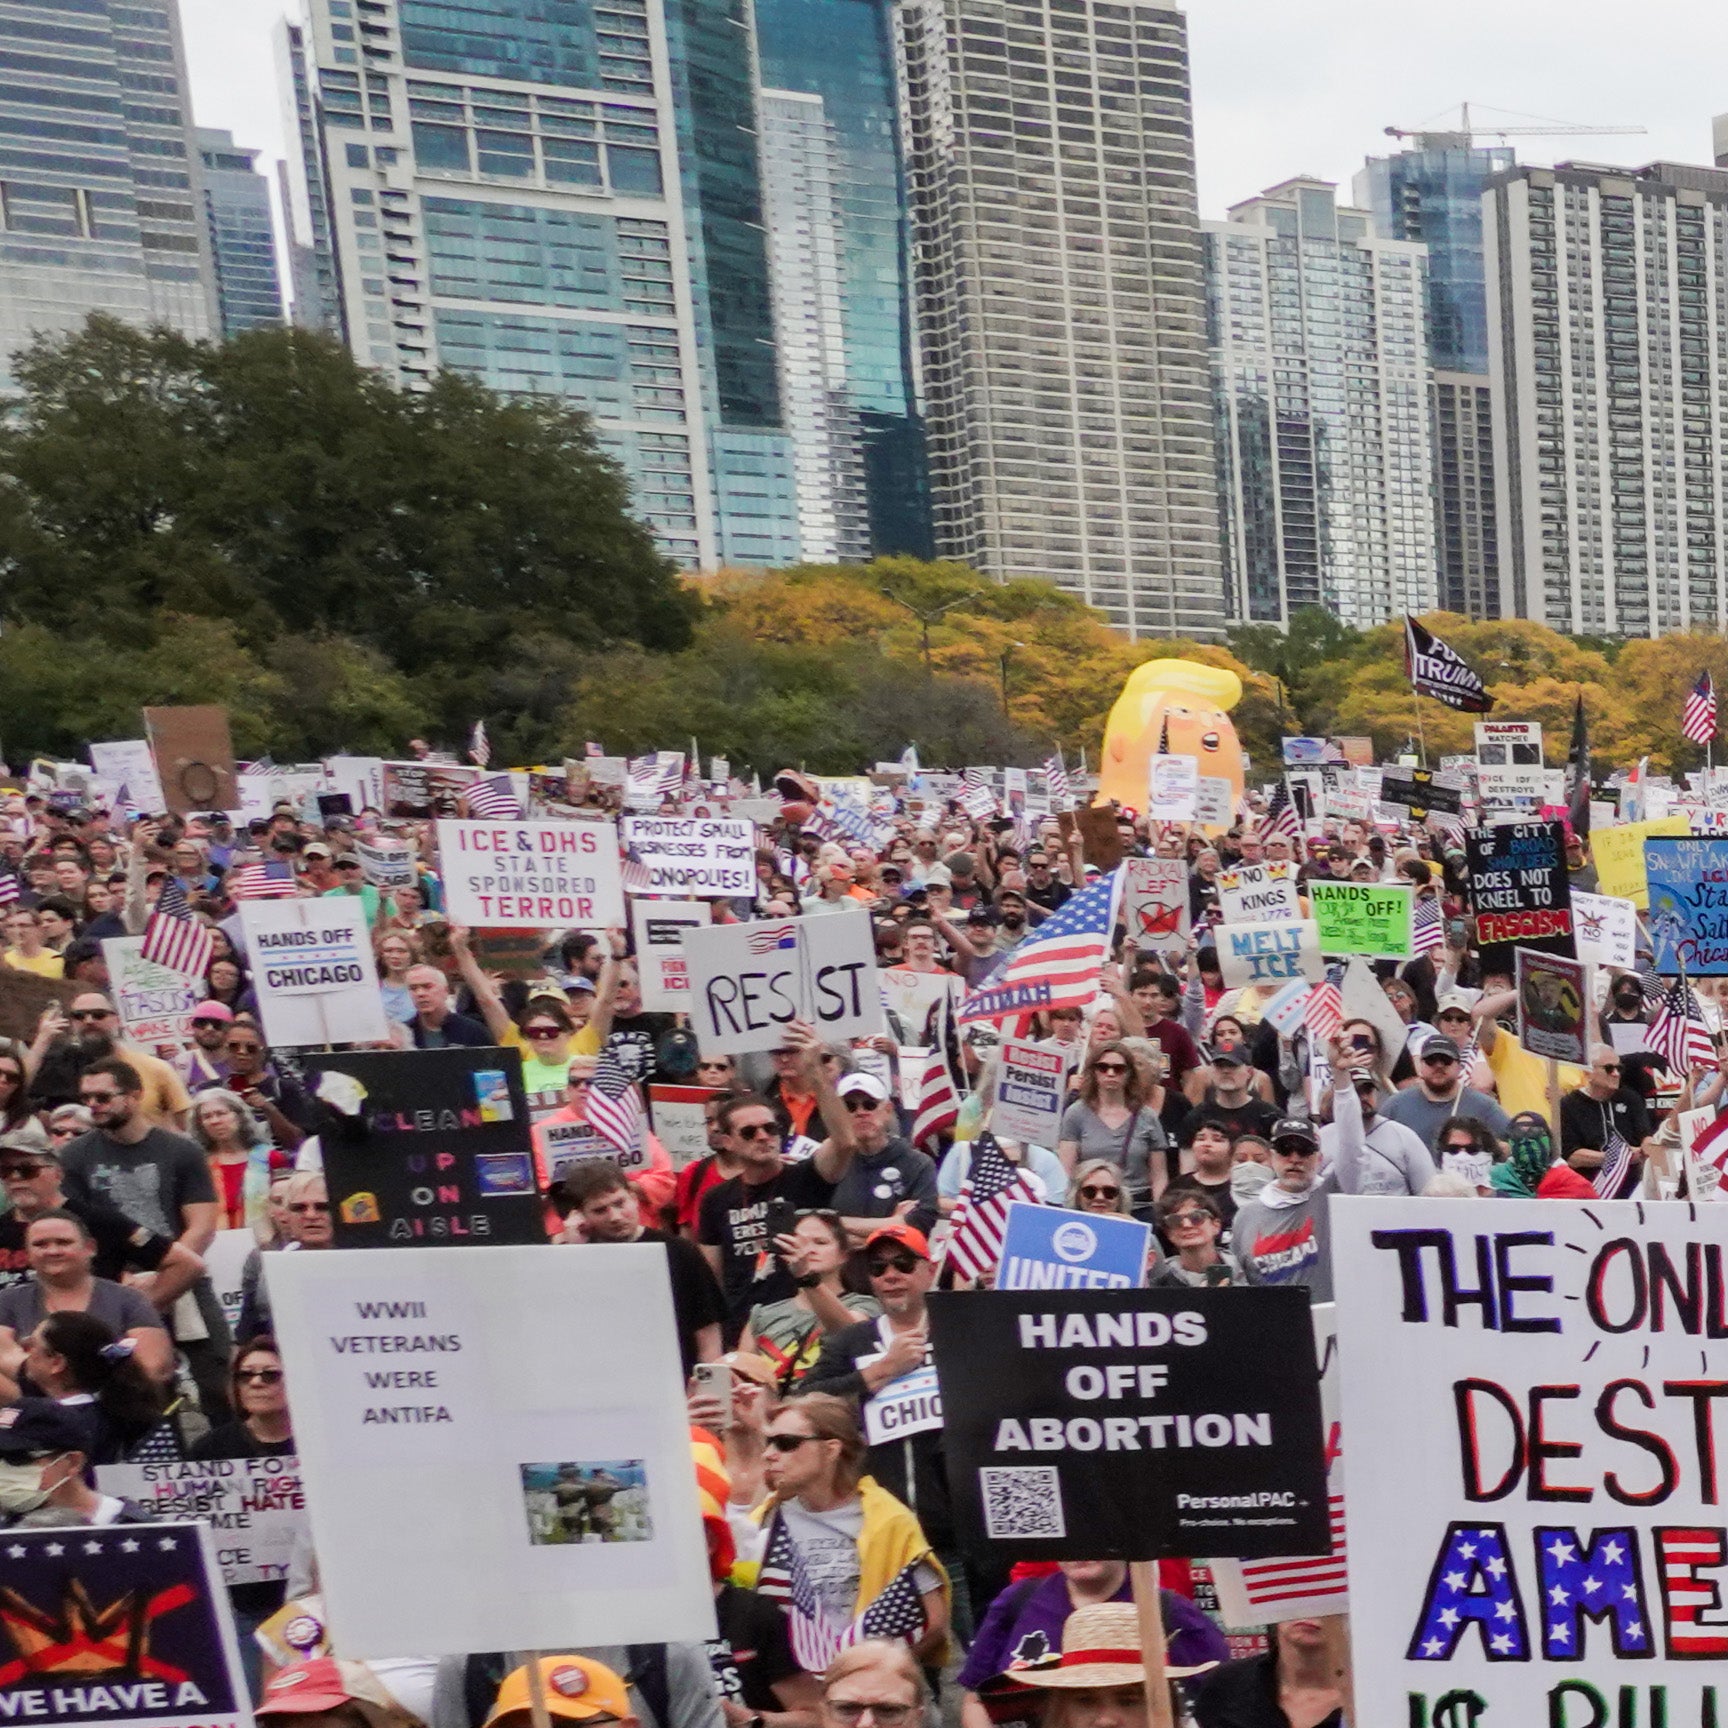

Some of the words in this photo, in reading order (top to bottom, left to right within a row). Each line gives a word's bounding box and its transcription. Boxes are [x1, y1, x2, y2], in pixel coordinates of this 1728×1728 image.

[633, 819, 693, 838] PROTECT
[458, 829, 509, 852] ICE
[539, 831, 598, 854] DHS
[494, 856, 569, 873] STATE
[468, 876, 596, 895] SPONSORED
[1475, 870, 1512, 887] DOES
[1519, 869, 1552, 886] NOT
[1240, 889, 1287, 912] KINGS
[1311, 885, 1371, 902] HANDS
[1475, 889, 1526, 908] KNEEL
[478, 896, 594, 919] TERROR
[258, 930, 317, 948] HANDS
[322, 928, 354, 944] OFF
[267, 964, 363, 988] CHICAGO
[413, 1185, 460, 1206] ON
[390, 1213, 491, 1239] AISLE
[1370, 1228, 1563, 1334] THE
[355, 1301, 427, 1320] WWII
[1019, 1310, 1208, 1350] HANDS
[329, 1332, 462, 1354] VETERANS
[364, 1369, 438, 1389] WERE
[1065, 1364, 1168, 1399] OFF
[362, 1404, 453, 1425] ANTIFA
[993, 1412, 1273, 1452] ABORTION
[143, 1460, 235, 1482] STAND
[52, 1681, 170, 1714] HAVE
